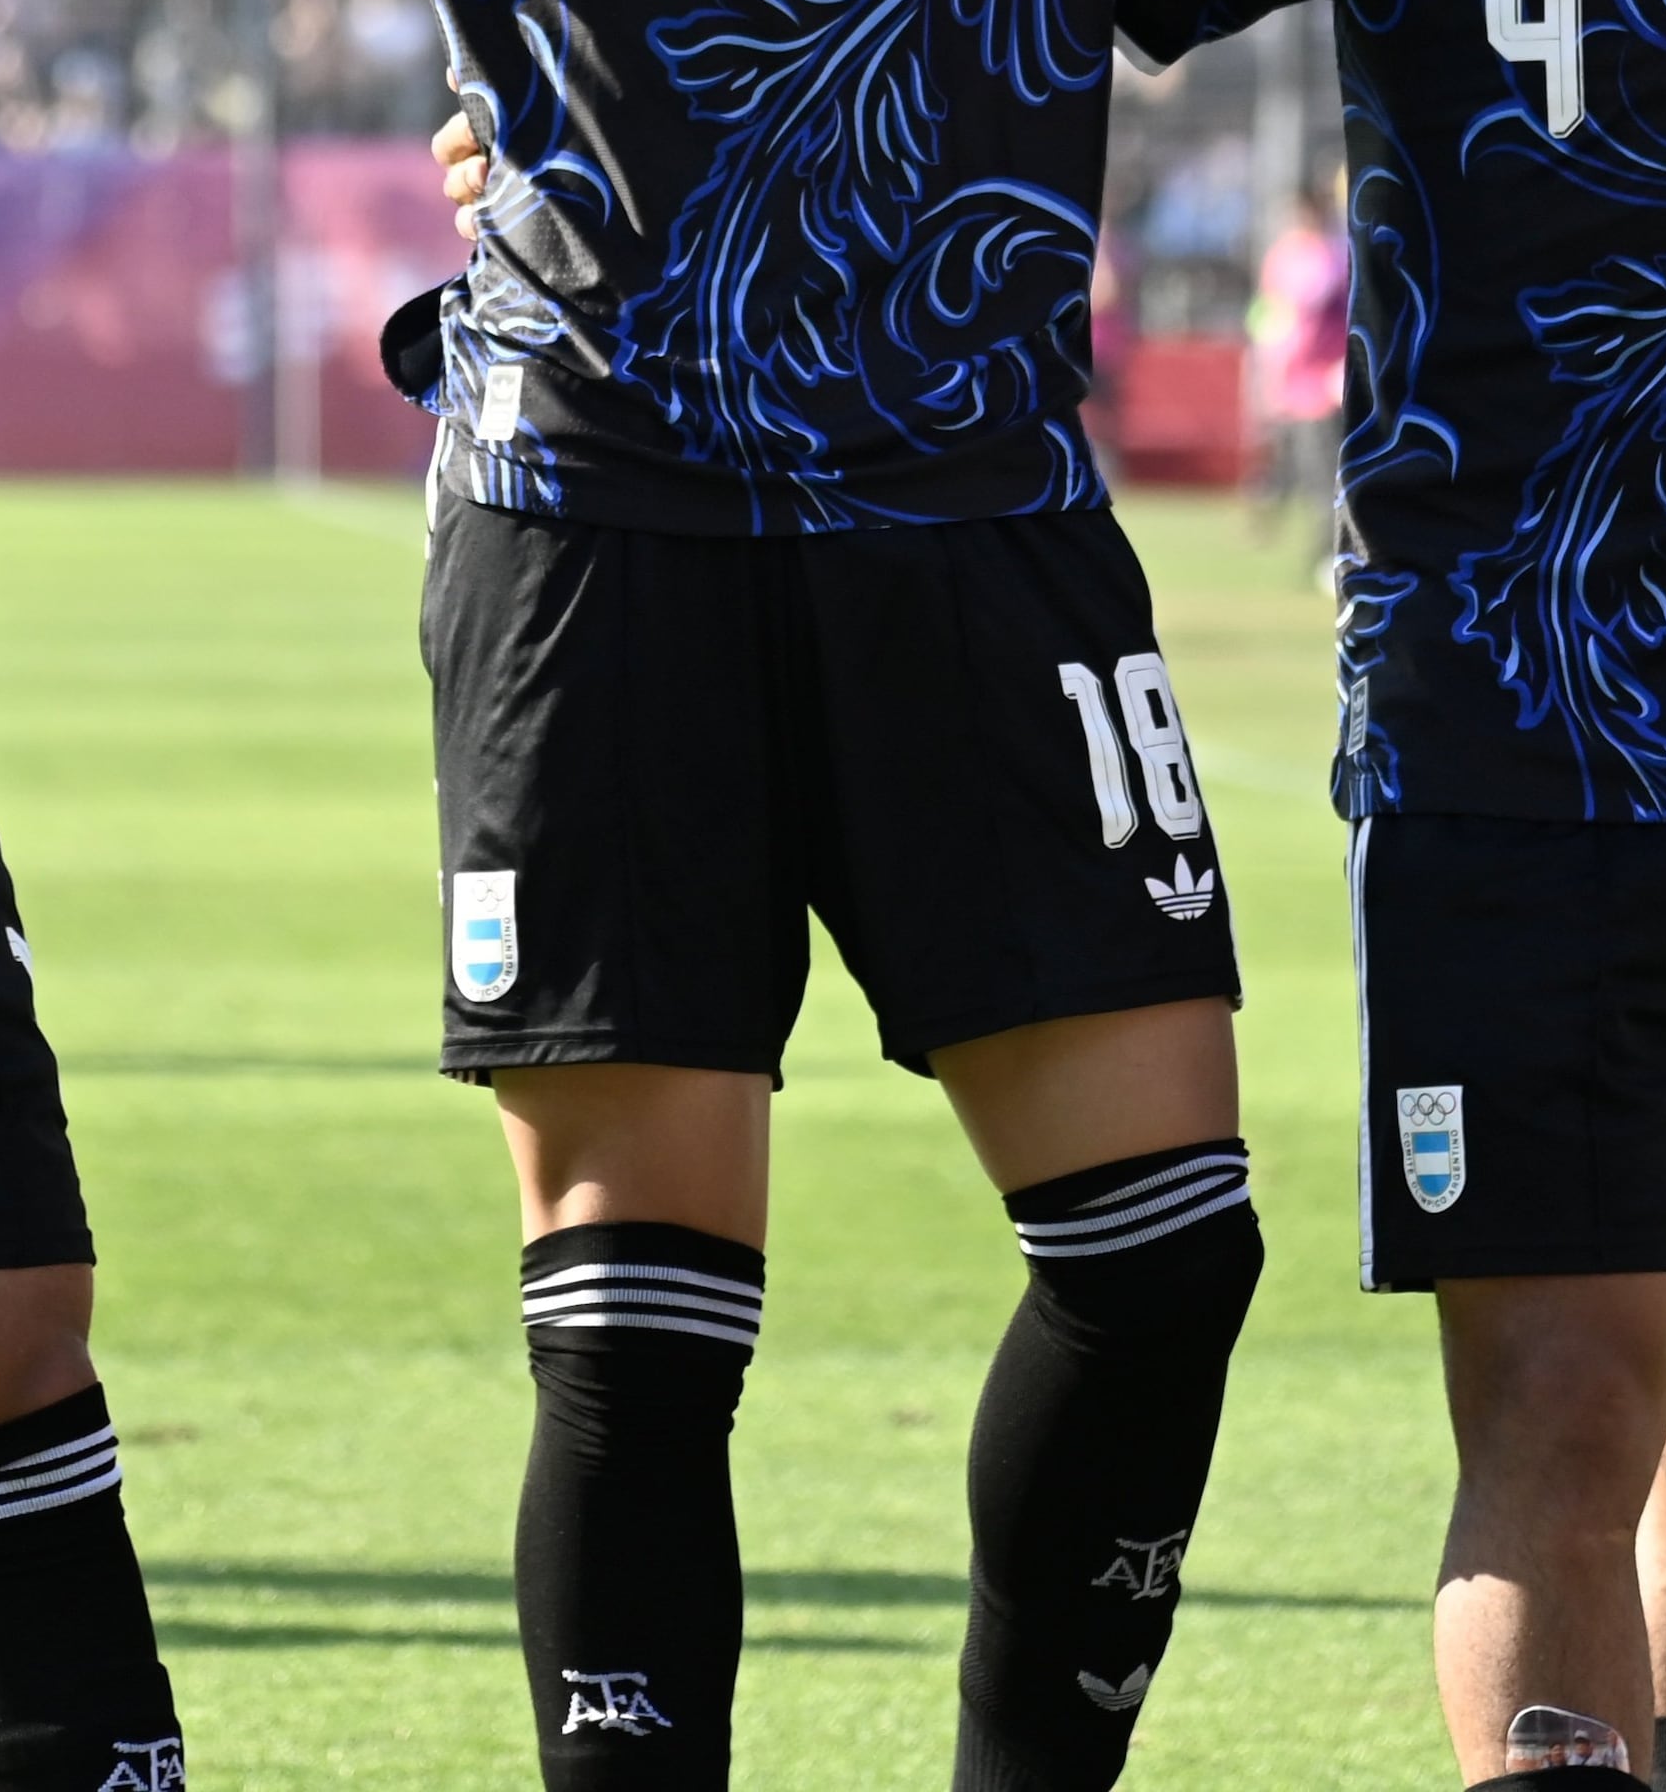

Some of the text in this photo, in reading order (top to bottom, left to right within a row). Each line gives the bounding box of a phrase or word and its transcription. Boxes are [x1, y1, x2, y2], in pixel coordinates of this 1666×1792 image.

[1058, 652, 1204, 849] 18
[1403, 1132, 1414, 1174] COMITE
[1448, 1129, 1461, 1197] ARGENTINO
[561, 1669, 673, 1736] AFA
